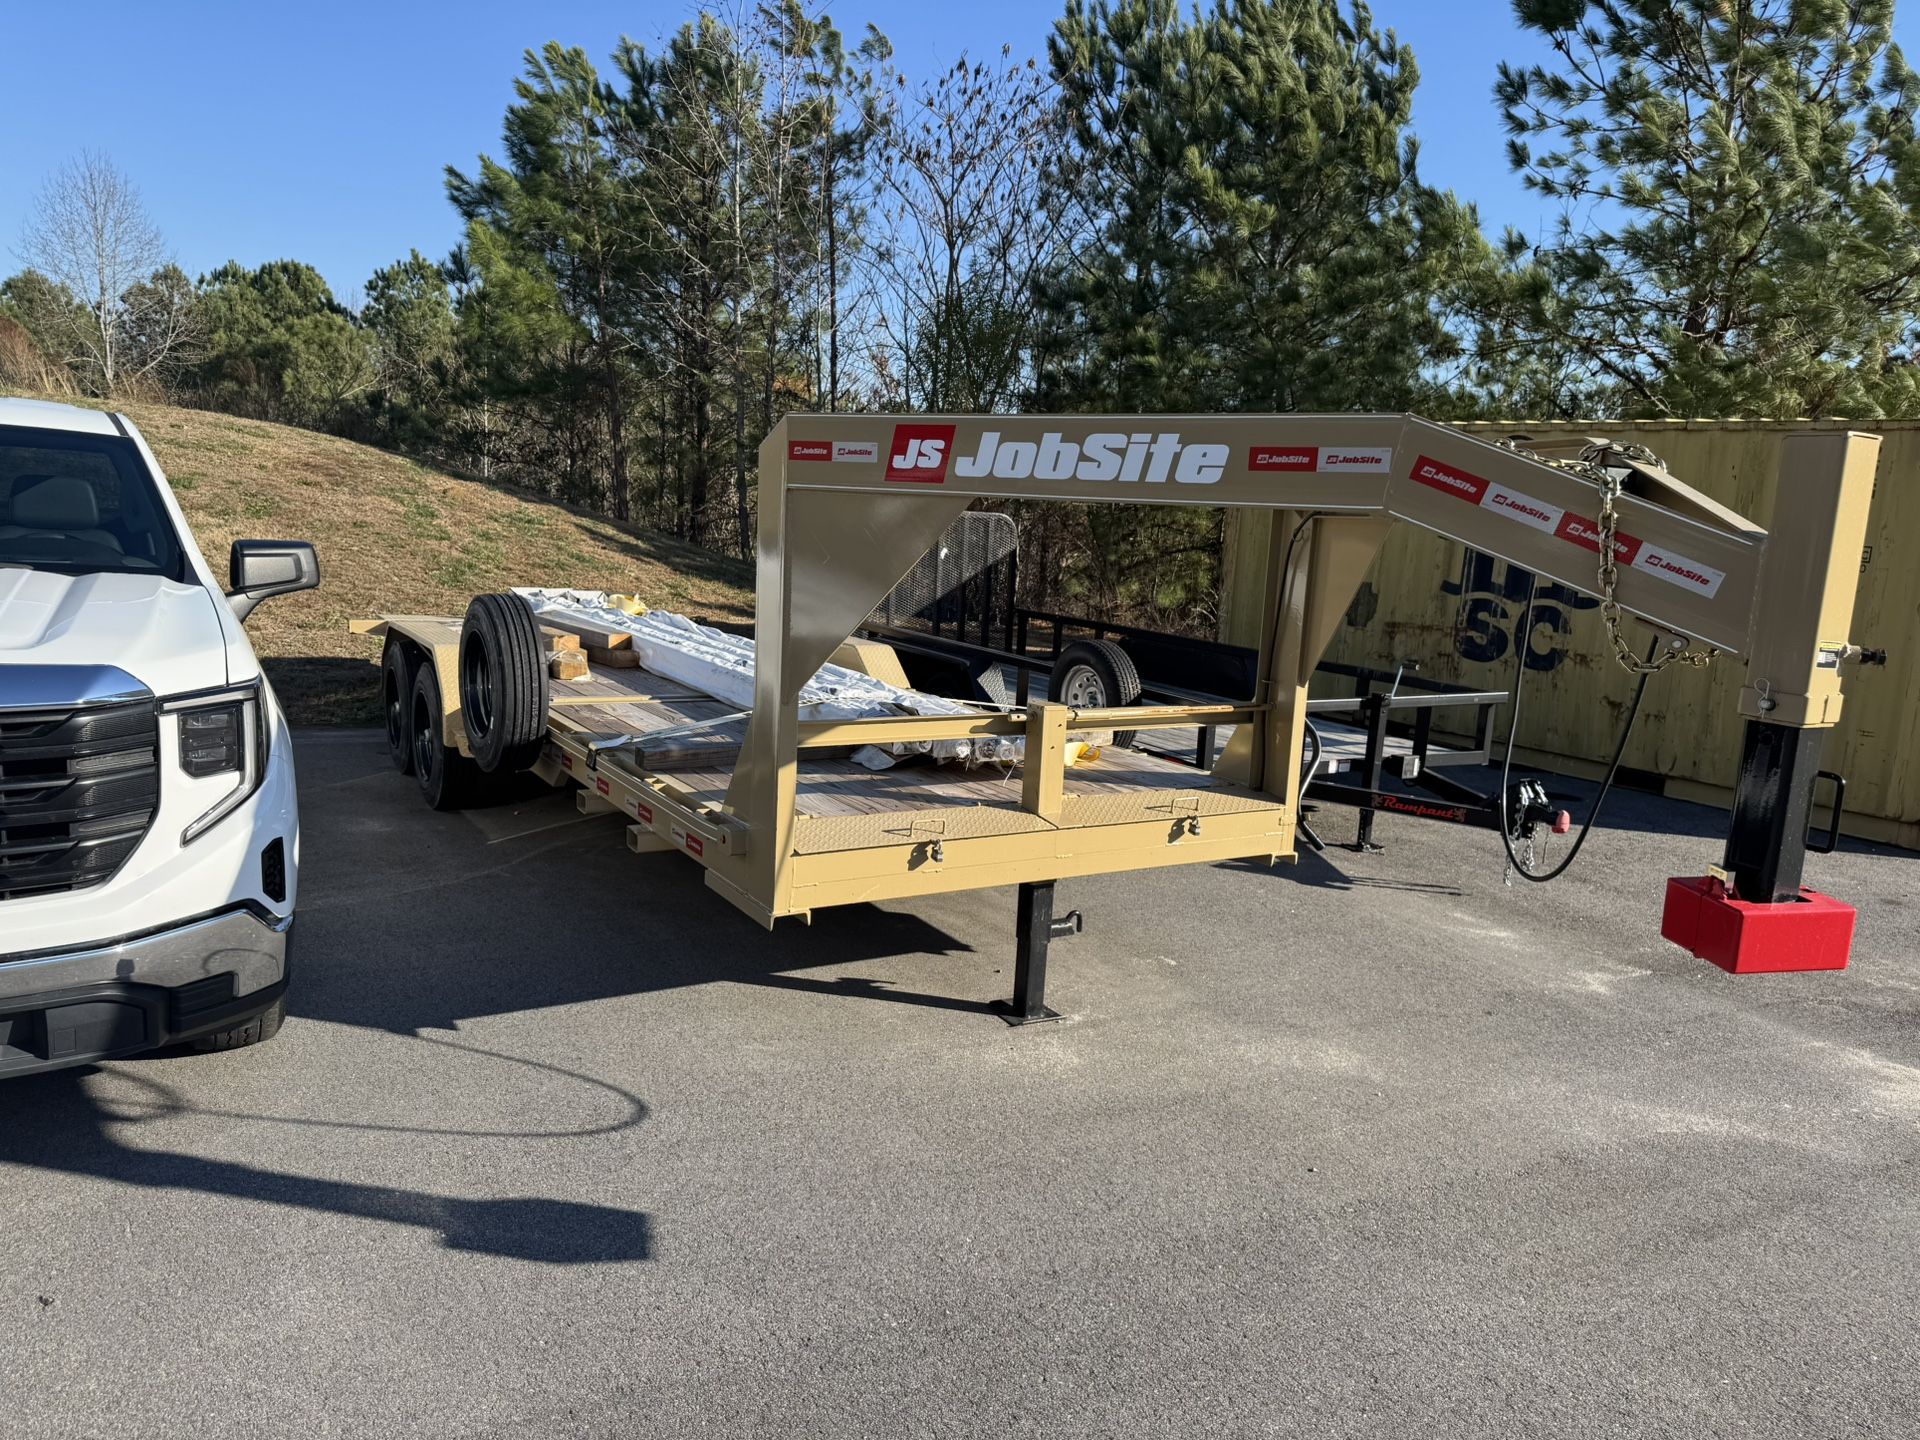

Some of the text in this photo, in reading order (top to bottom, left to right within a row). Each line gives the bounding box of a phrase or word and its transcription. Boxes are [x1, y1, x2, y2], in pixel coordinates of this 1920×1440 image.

[801, 447, 828, 455] JobSite
[845, 448, 873, 456] JobSite
[892, 431, 1230, 484] JS JobSite
[1268, 455, 1310, 464] JobSite
[1338, 456, 1383, 465] JobSite
[1433, 472, 1478, 493] JobSite
[1505, 500, 1551, 522] JobSite
[1659, 561, 1711, 586] JobSite
[1383, 796, 1454, 818] Rampant
